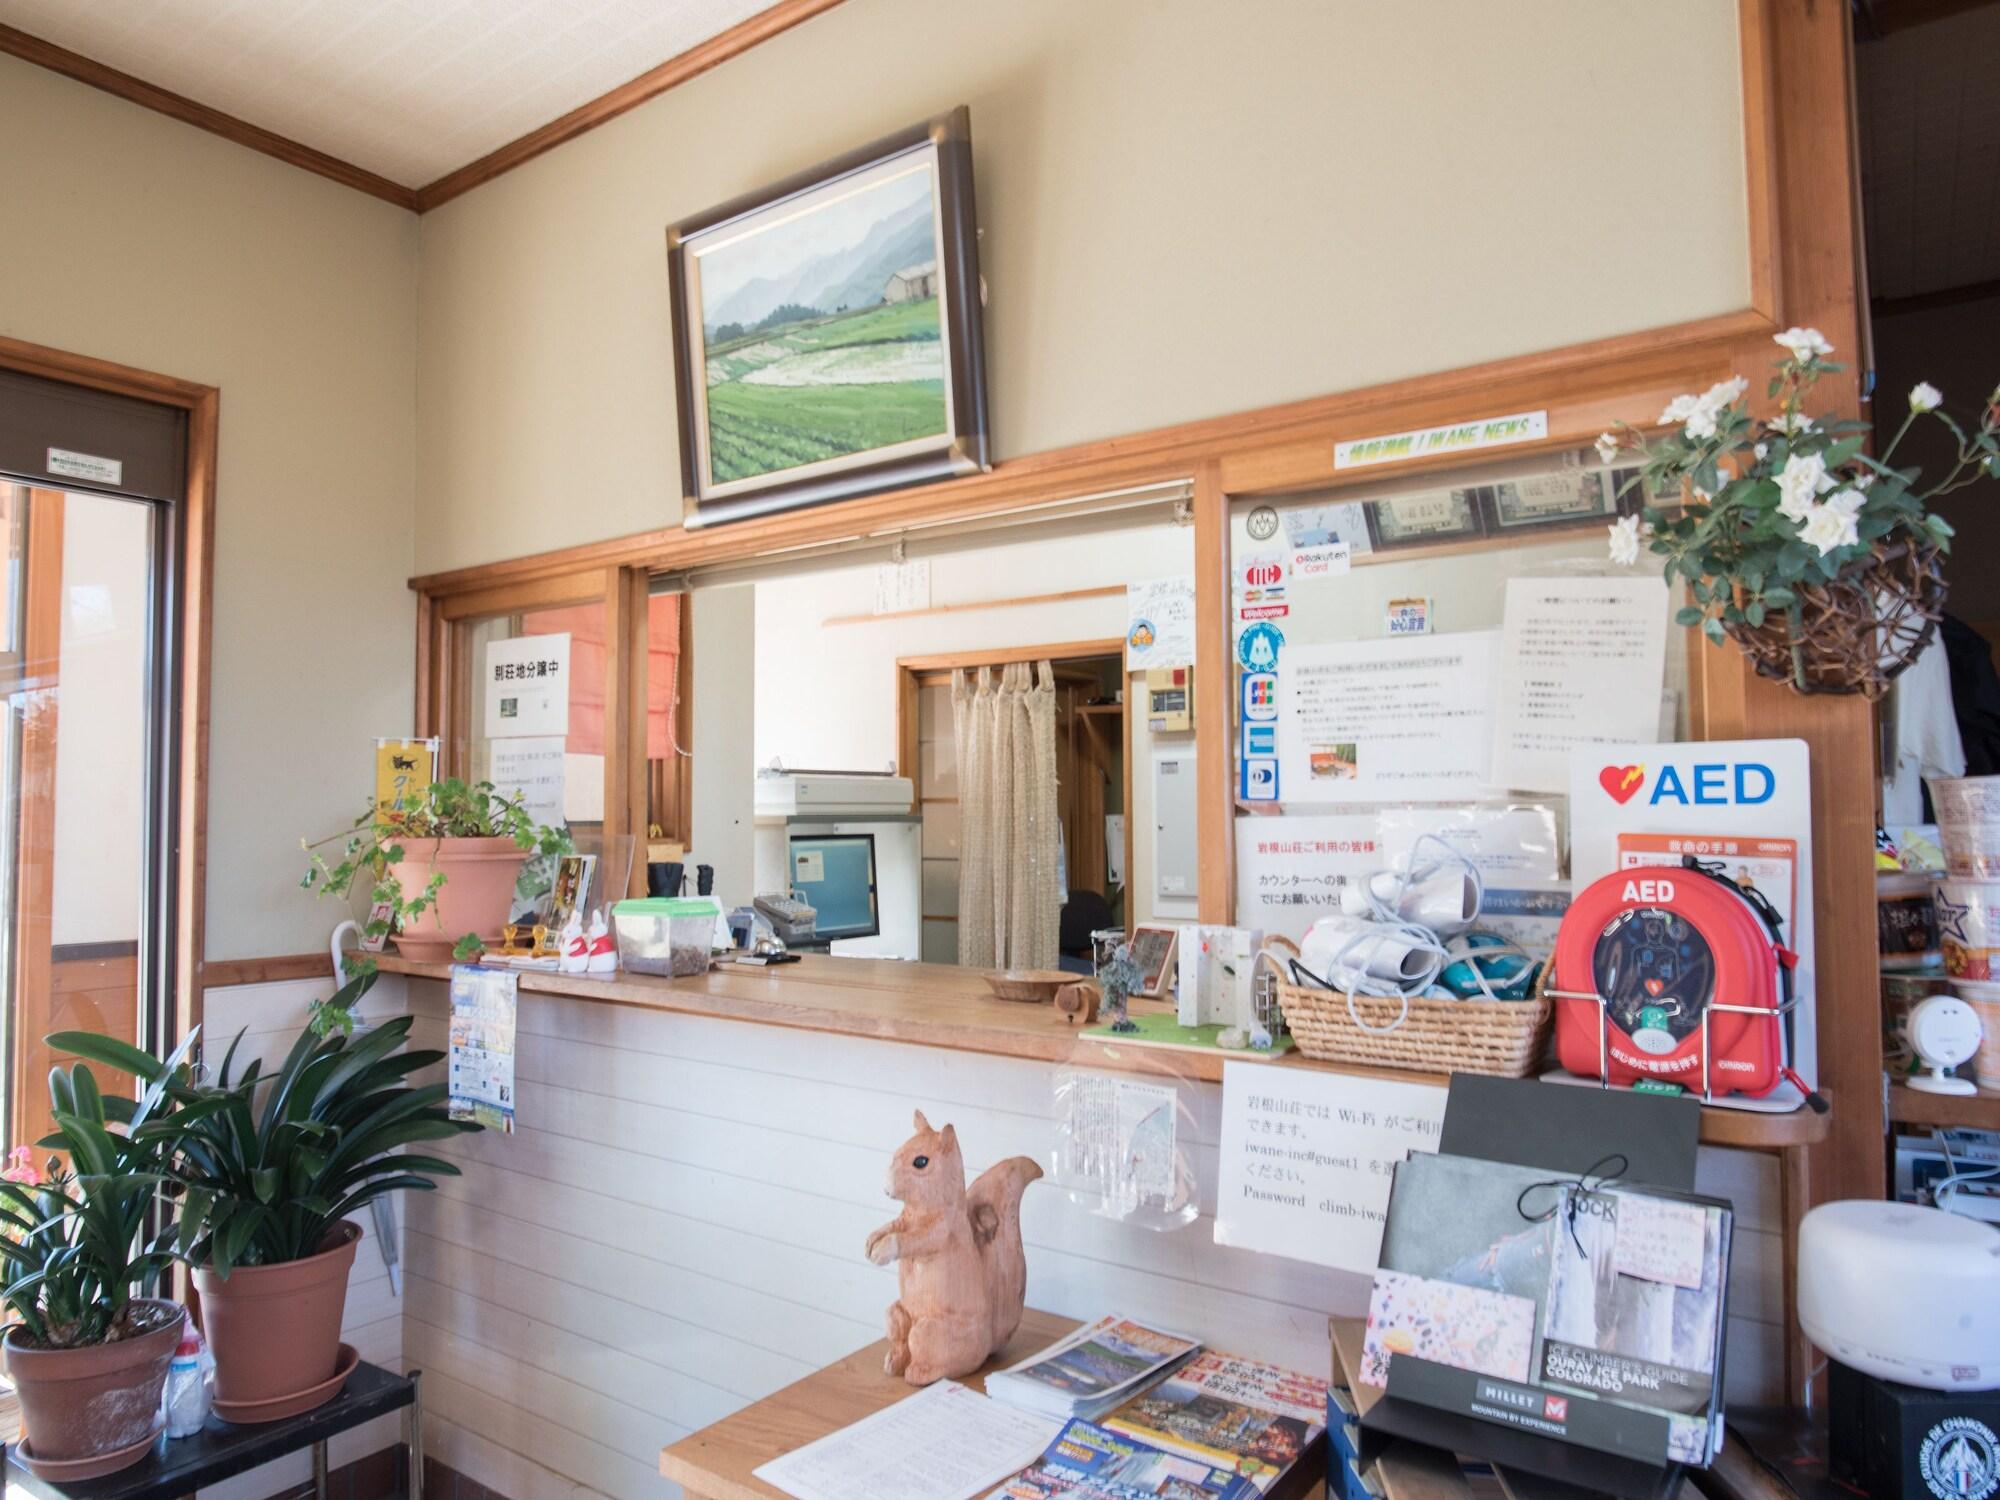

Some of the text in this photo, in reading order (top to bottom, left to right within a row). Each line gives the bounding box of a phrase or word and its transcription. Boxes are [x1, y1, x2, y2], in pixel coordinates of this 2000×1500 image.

[1428, 425, 1479, 449] IWANE
[1483, 417, 1530, 441] NEWS
[1304, 563, 1328, 573] Card
[1305, 551, 1347, 562] Rakuten
[494, 659, 559, 682] 別荘地分譲中
[1650, 763, 1776, 805] AED
[1621, 880, 1675, 903] AED
[1247, 1095, 1330, 1120] 岩根山荘では
[1338, 1108, 1376, 1127] Wi-Fi
[1247, 1118, 1308, 1140] できます。
[1245, 1162, 1306, 1186] ください。
[1243, 1185, 1306, 1208] Password
[1547, 1354, 1660, 1391] OURAY ICE PARK
[1548, 1343, 1689, 1386] ICE CLIMBER'S GUIDE
[1546, 1365, 1624, 1393] COLORADO
[1485, 1386, 1535, 1408] MILLET
[1471, 1402, 1567, 1436] MOUNTAIN BY EXPERIENCE
